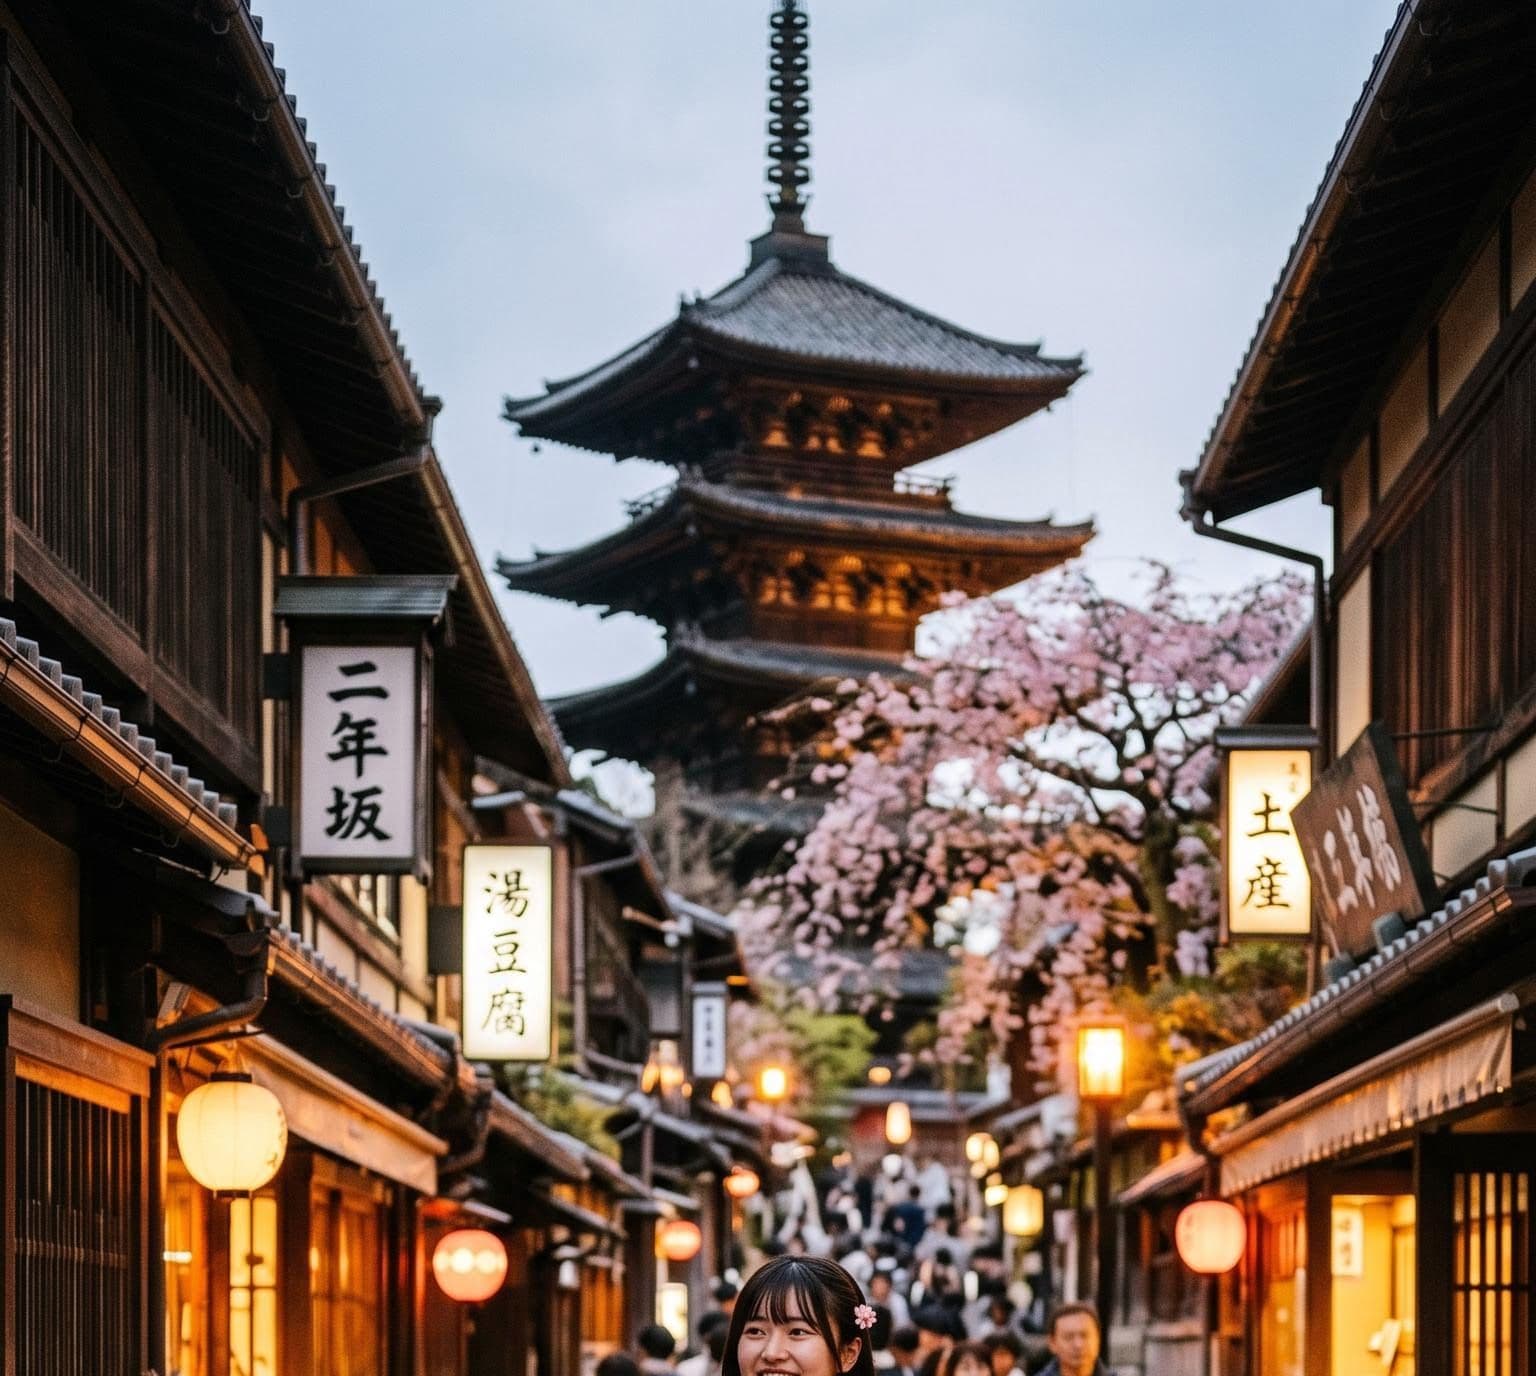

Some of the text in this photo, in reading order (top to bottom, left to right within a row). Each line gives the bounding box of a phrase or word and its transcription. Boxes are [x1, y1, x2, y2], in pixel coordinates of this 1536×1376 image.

[325, 661, 392, 841] 二年坂
[1241, 793, 1291, 908] 土産
[482, 870, 531, 1036] 湯豆腐
